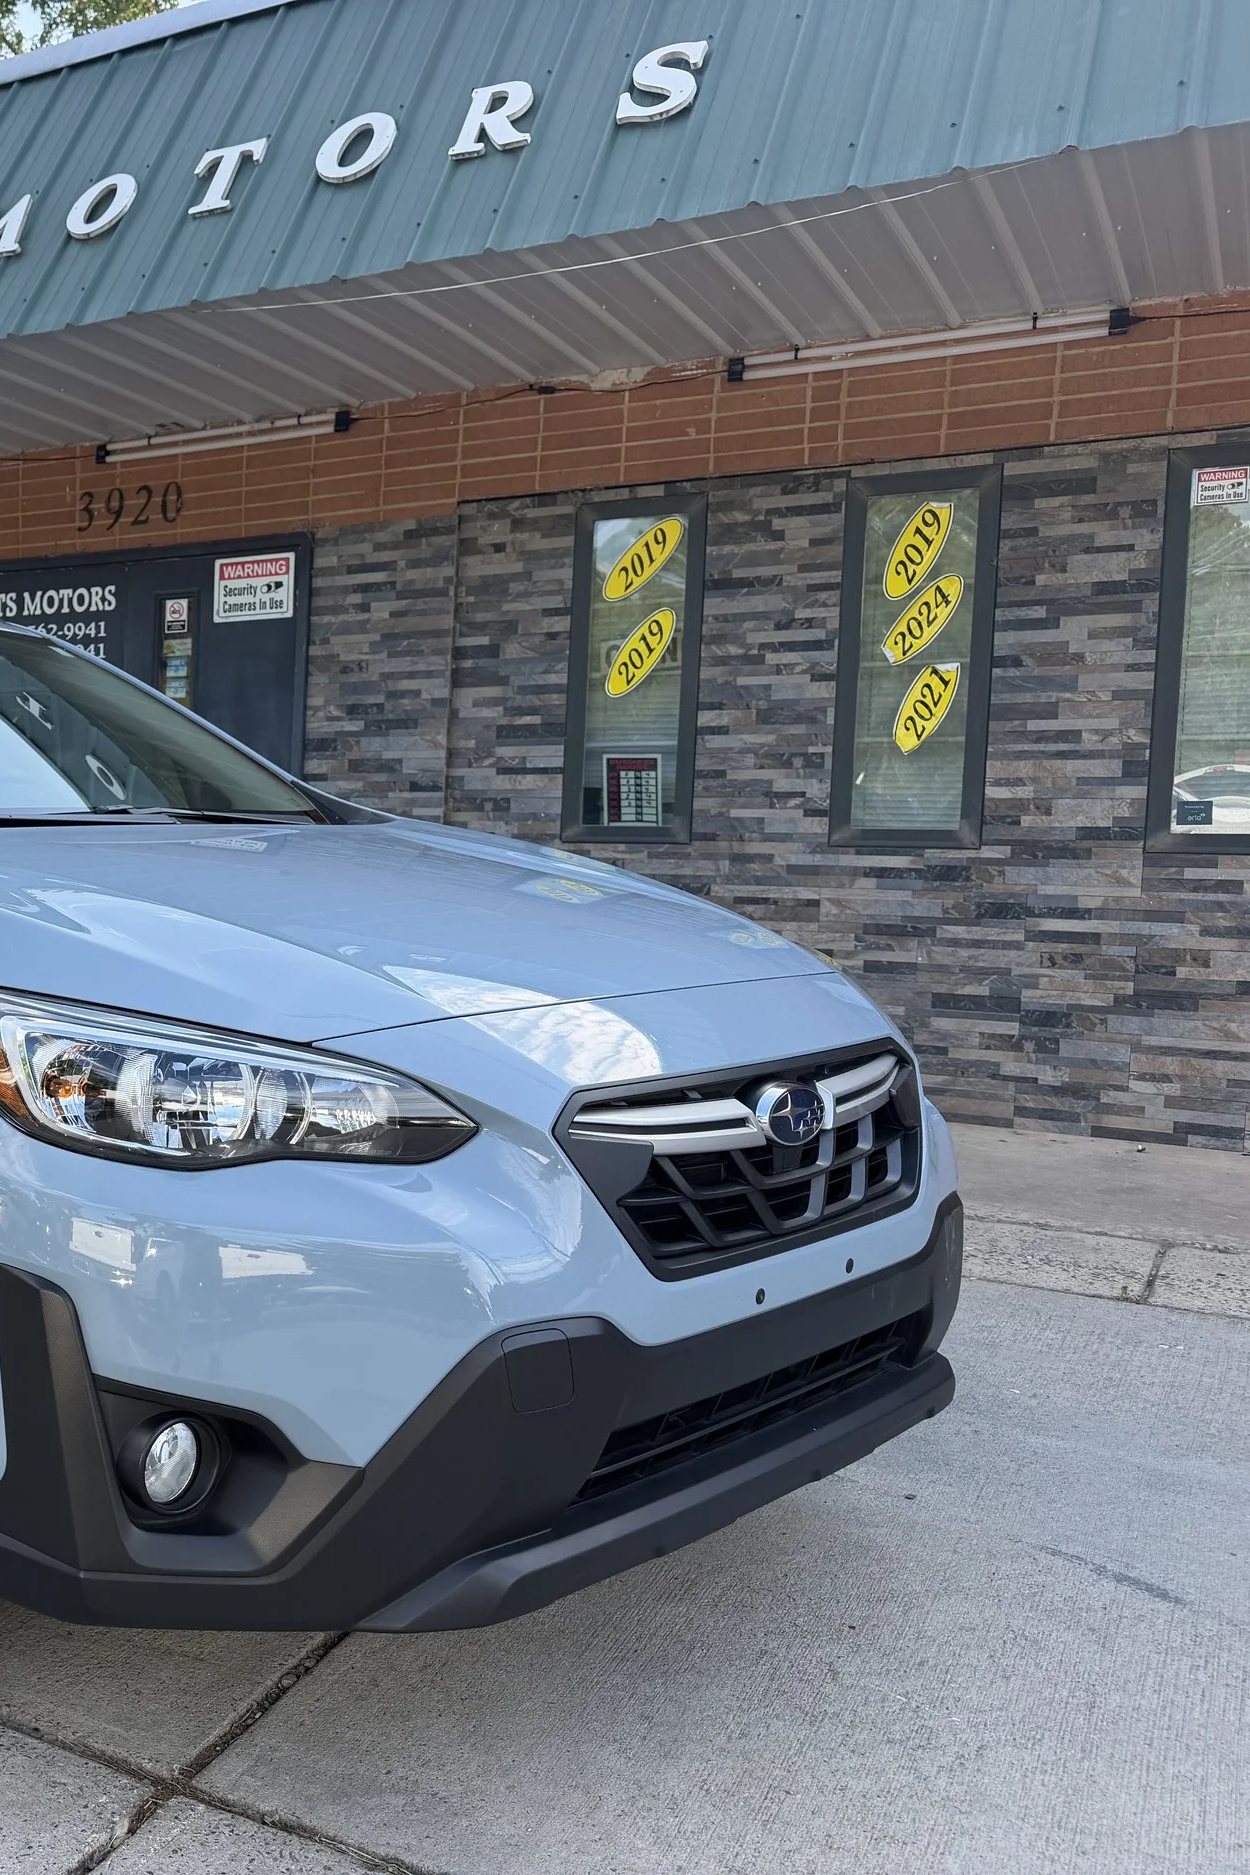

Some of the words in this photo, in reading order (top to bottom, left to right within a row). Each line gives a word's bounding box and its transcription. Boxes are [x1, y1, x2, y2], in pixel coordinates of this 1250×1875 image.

[1200, 470, 1245, 481] WARNING
[1200, 483, 1225, 492] Security
[77, 481, 183, 532] 3920
[1200, 493, 1225, 501] Cameras
[618, 527, 667, 593] 2019
[895, 508, 942, 586] 2019
[223, 560, 286, 579] WARNING
[22, 585, 117, 616] MOTORS
[222, 599, 257, 613] Cameras
[259, 598, 267, 611] In
[269, 597, 284, 610] Use
[223, 583, 258, 598] Security
[893, 584, 952, 657] 2024
[618, 619, 664, 687] 2019
[904, 666, 952, 742] 2021
